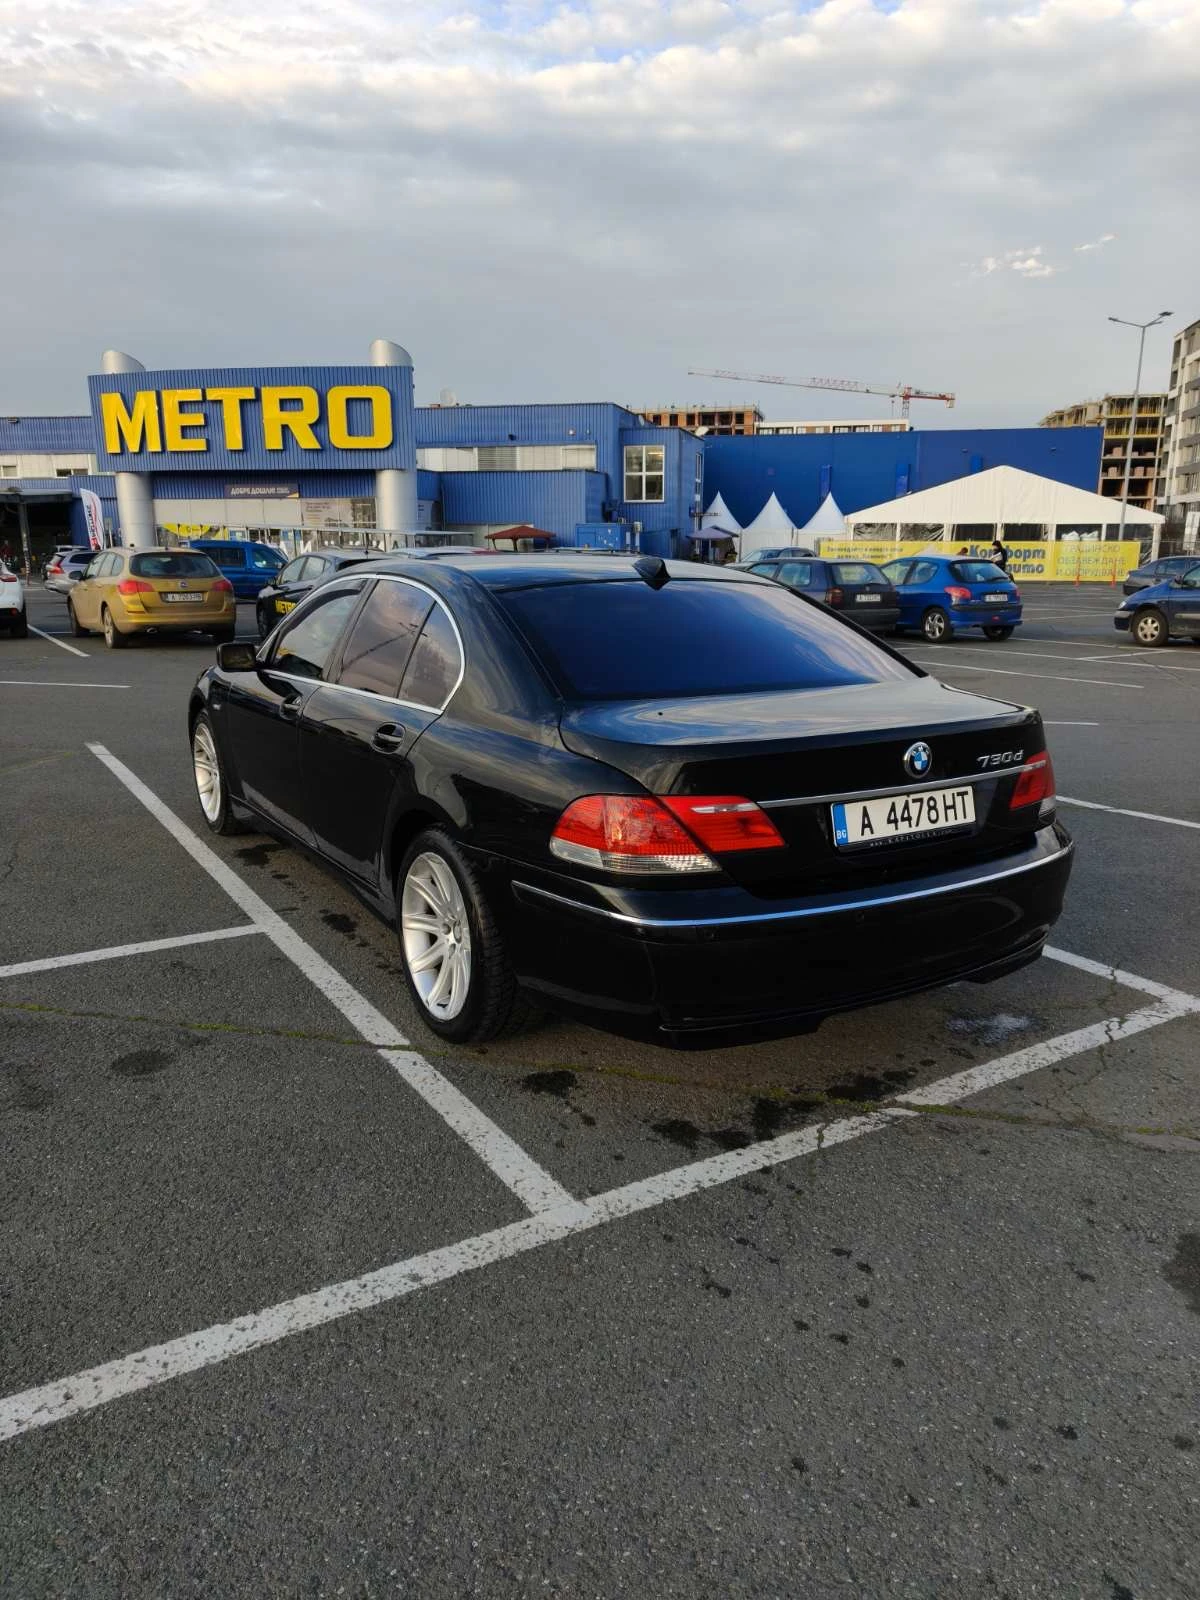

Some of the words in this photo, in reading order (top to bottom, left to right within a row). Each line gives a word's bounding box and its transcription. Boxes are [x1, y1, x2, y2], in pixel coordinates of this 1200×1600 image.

[101, 385, 393, 453] METRO
[977, 749, 1024, 768] 730d
[861, 806, 874, 836] A
[836, 829, 847, 840] BG
